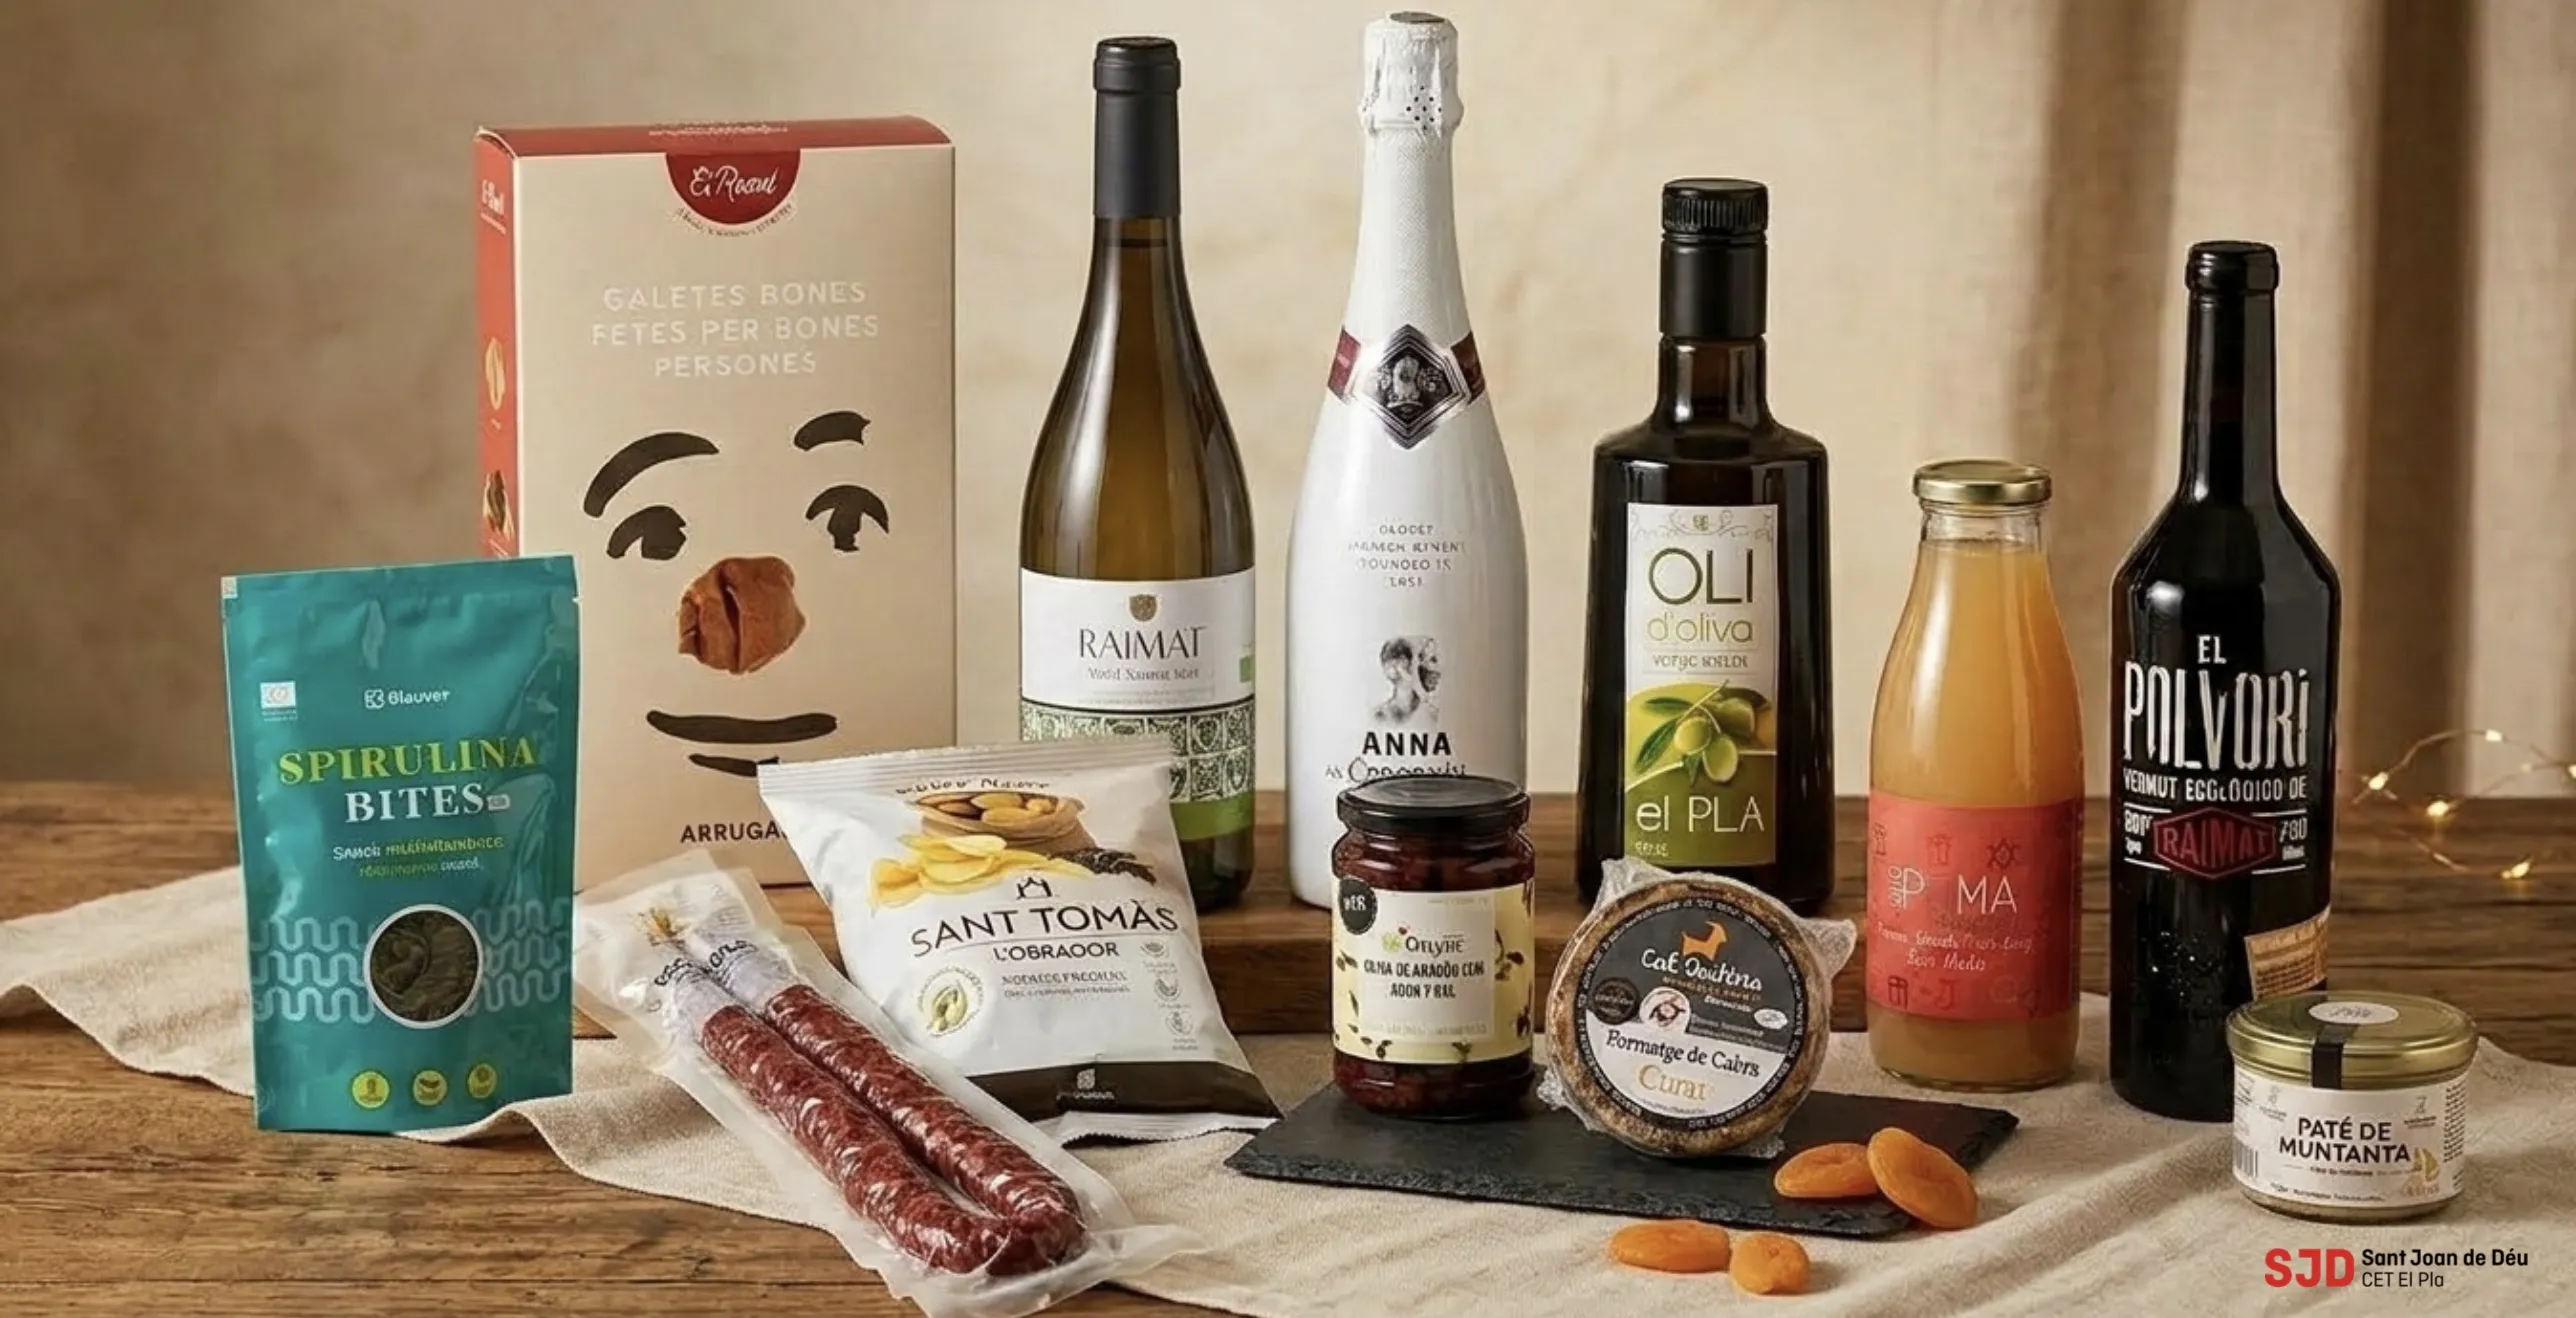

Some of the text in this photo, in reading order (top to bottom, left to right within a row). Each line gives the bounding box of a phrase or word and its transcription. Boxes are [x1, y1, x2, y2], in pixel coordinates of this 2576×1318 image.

[604, 281, 867, 312] GALETES BONES
[591, 313, 879, 346] FETES PER BONES
[653, 352, 817, 378] PERSONES
[1648, 547, 1754, 605] OLI
[1079, 626, 1207, 660] RAIMAT
[1646, 611, 1754, 644] d'oliva
[2197, 634, 2228, 665] EL
[1362, 731, 1452, 756] ANNA
[278, 736, 538, 786] SPIRULINA
[345, 782, 484, 823] BITES
[1635, 795, 1765, 833] el PLA
[680, 820, 788, 844] ARRUGA
[2161, 817, 2271, 869] RAIMAT
[911, 898, 1180, 958] SANT TOMÀS
[1687, 1045, 1708, 1066] de
[2298, 1116, 2354, 1141] PATÉ
[2360, 1122, 2393, 1142] DE
[2279, 1136, 2412, 1165] MUNTANTA
